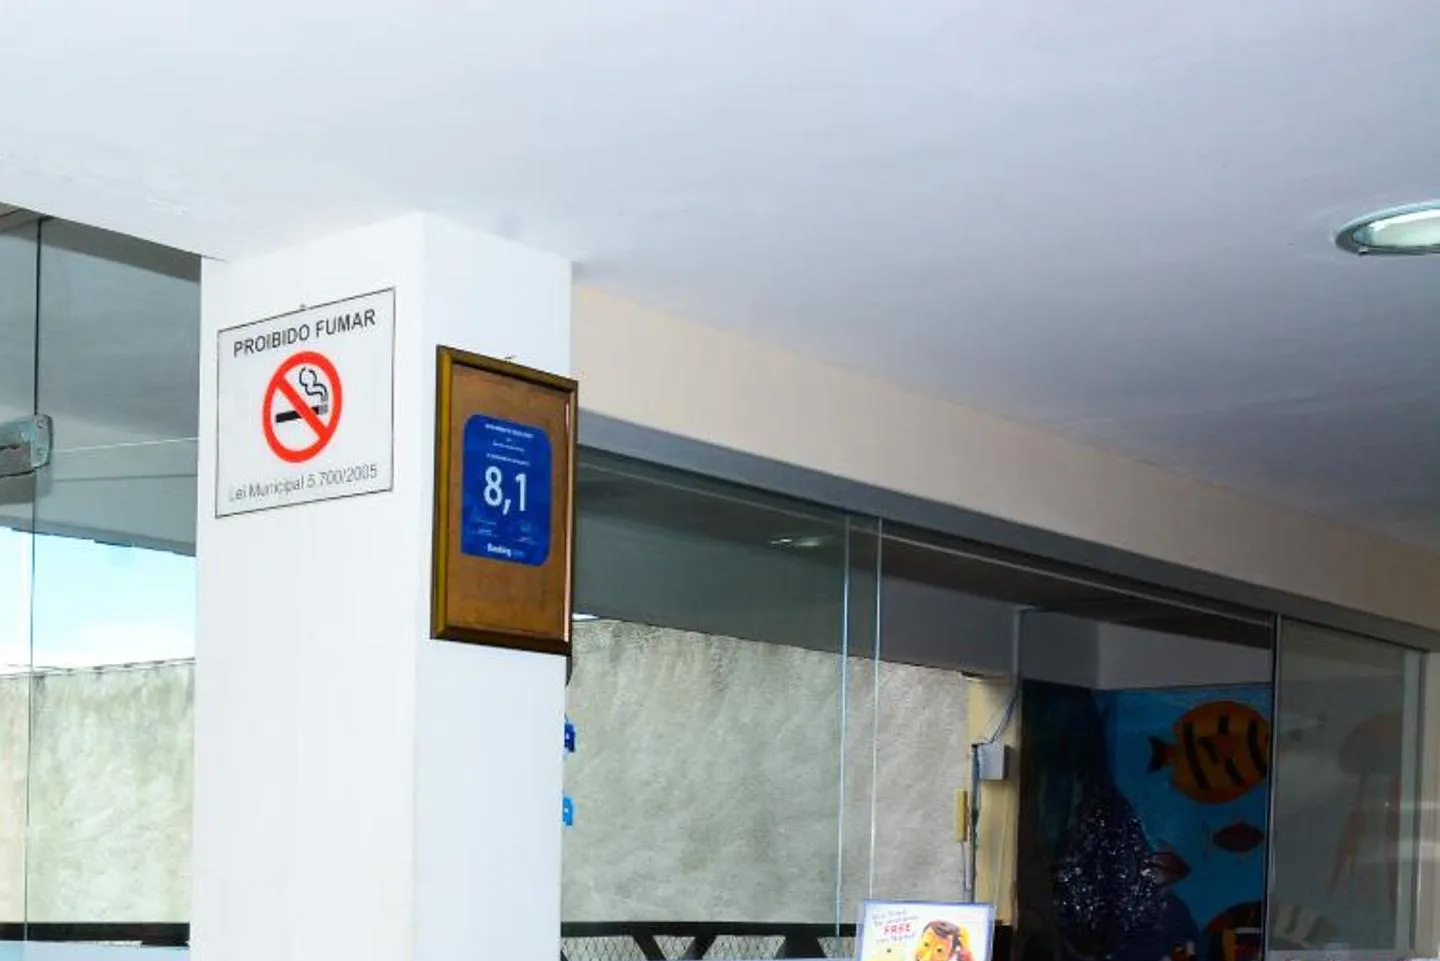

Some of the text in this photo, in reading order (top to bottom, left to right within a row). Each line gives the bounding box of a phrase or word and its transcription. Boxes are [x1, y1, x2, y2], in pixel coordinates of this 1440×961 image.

[233, 308, 377, 359] PROIBIDO FUMAR
[228, 485, 247, 502] Lei
[248, 474, 305, 500] Municipal
[483, 465, 527, 516] 8,1
